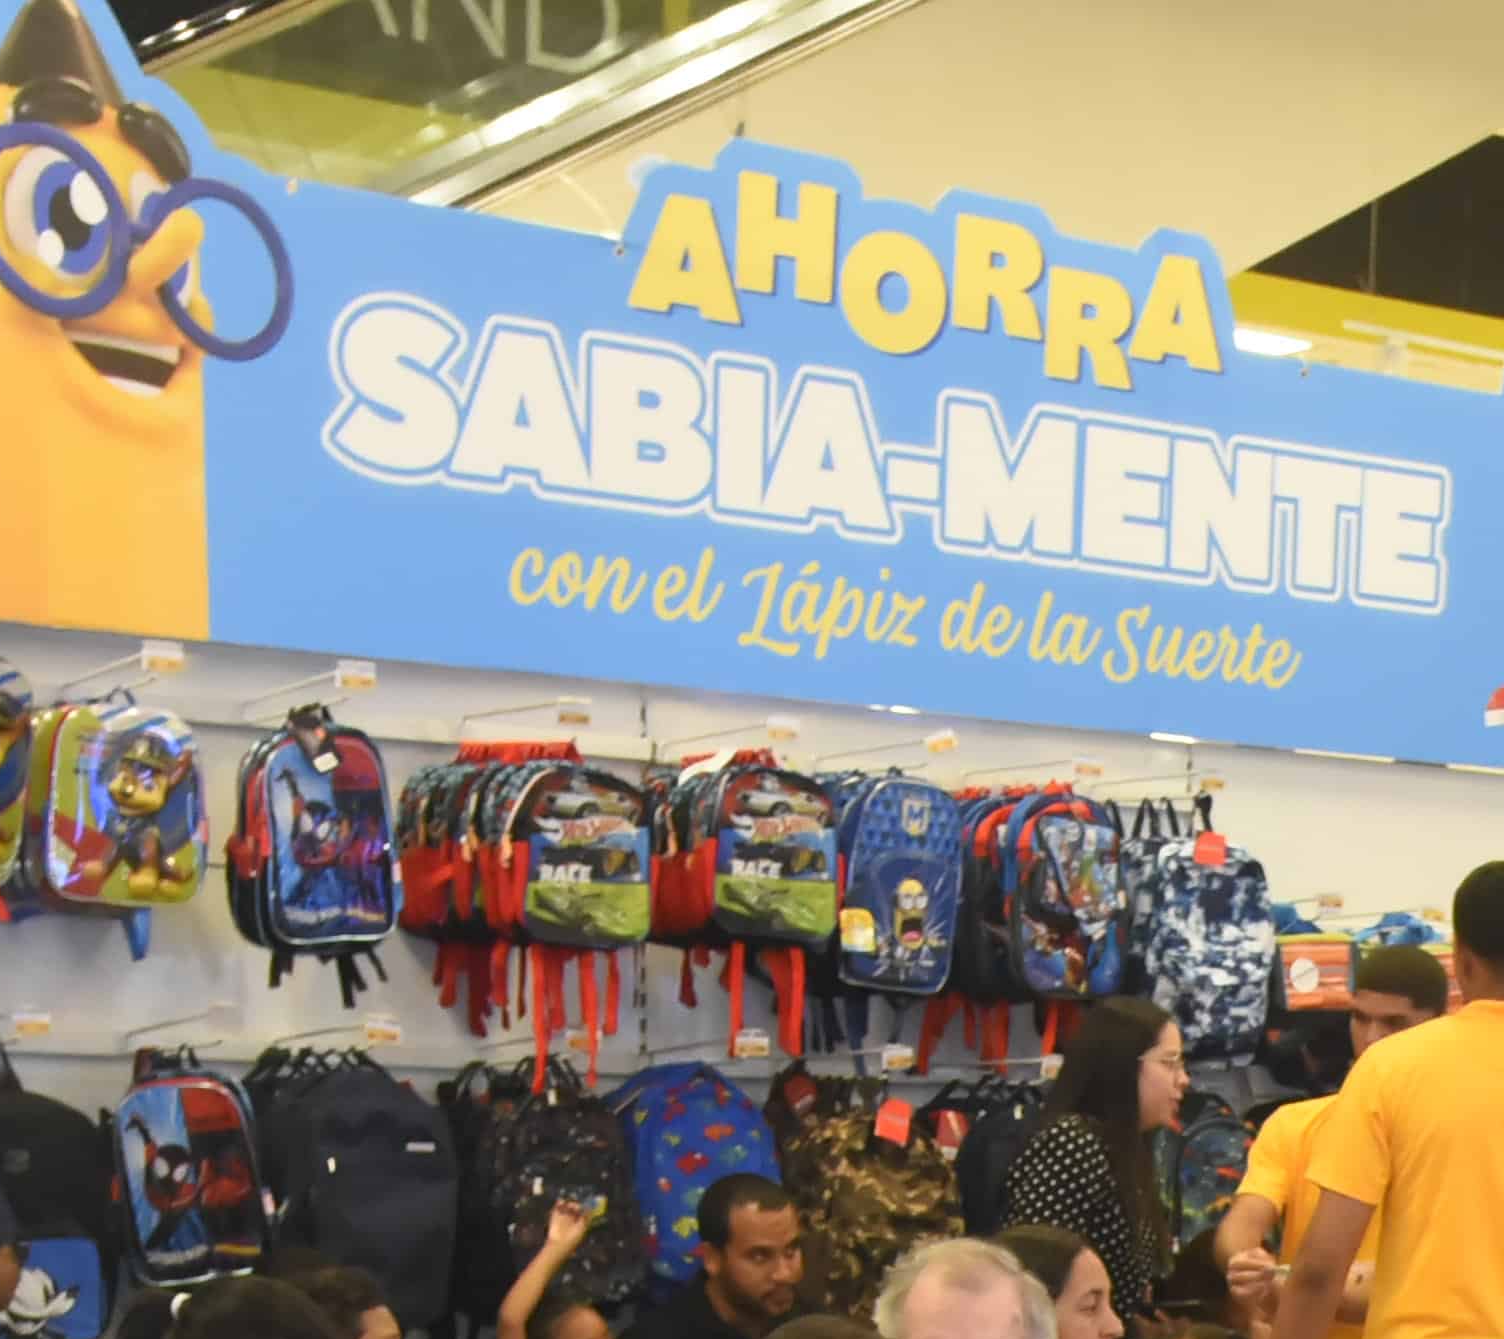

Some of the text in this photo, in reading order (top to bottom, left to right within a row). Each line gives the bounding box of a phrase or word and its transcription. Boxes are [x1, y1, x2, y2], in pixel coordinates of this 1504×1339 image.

[626, 172, 1224, 390] AHORRA
[324, 295, 1448, 613] SABIA-MENTE
[508, 546, 1302, 689] con el Lápiz de la Suerte
